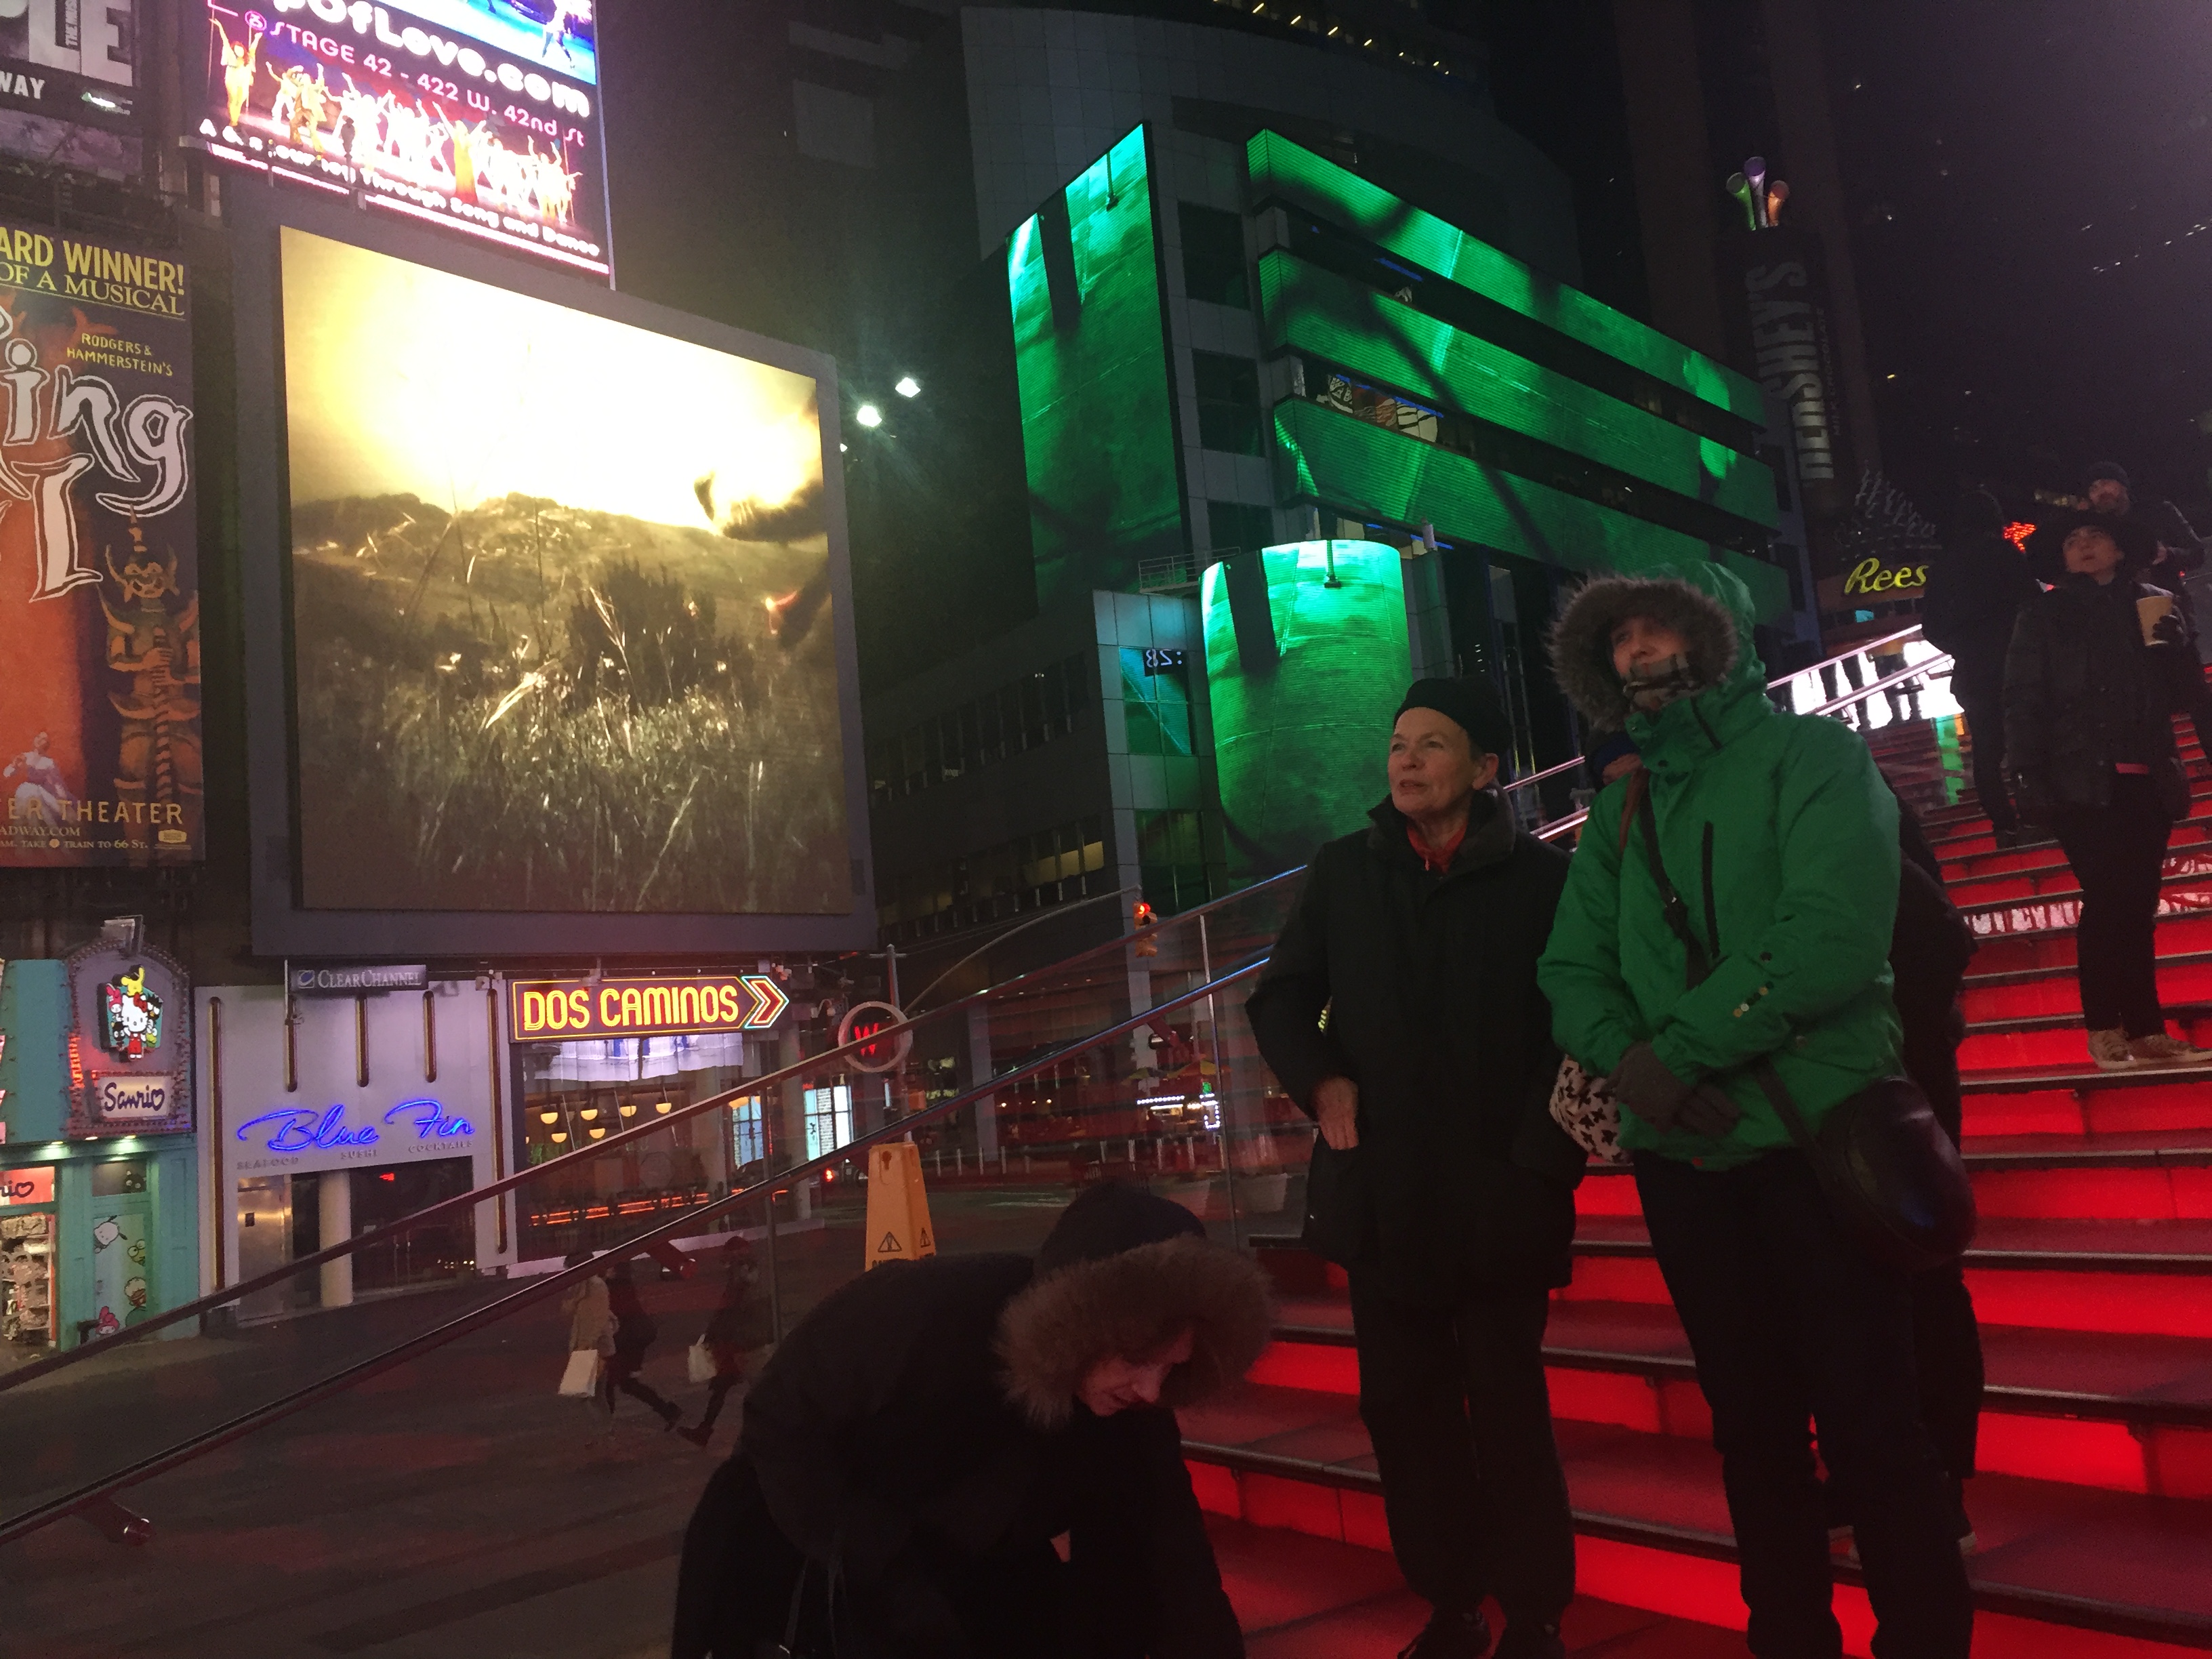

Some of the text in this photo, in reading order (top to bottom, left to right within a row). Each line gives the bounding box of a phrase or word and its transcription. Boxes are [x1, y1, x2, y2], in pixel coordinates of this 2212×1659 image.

[270, 21, 355, 64] STAGE
[363, 54, 392, 78] 42
[417, 73, 459, 102] 422
[467, 89, 497, 115] W.
[504, 104, 558, 137] 42nd
[62, 240, 185, 295] WINNER!
[37, 270, 58, 291] A
[64, 274, 185, 316] MUSICAL
[81, 333, 153, 356] RODGERS &
[66, 347, 173, 377] HAMMERSTEIN'S
[0, 308, 194, 518] ing
[59, 798, 183, 825] THEATER
[21, 840, 47, 848] TAKE
[64, 840, 94, 848] TRAIN
[98, 840, 112, 848] TO
[114, 839, 129, 848] 66
[523, 985, 739, 1031] DOS CAMINOS
[853, 1023, 879, 1057] W
[103, 1082, 165, 1112] Sanrio
[237, 1099, 475, 1153] Blue Fin
[237, 1140, 473, 1170] SEAFOOD SUSHI COCKTAILS
